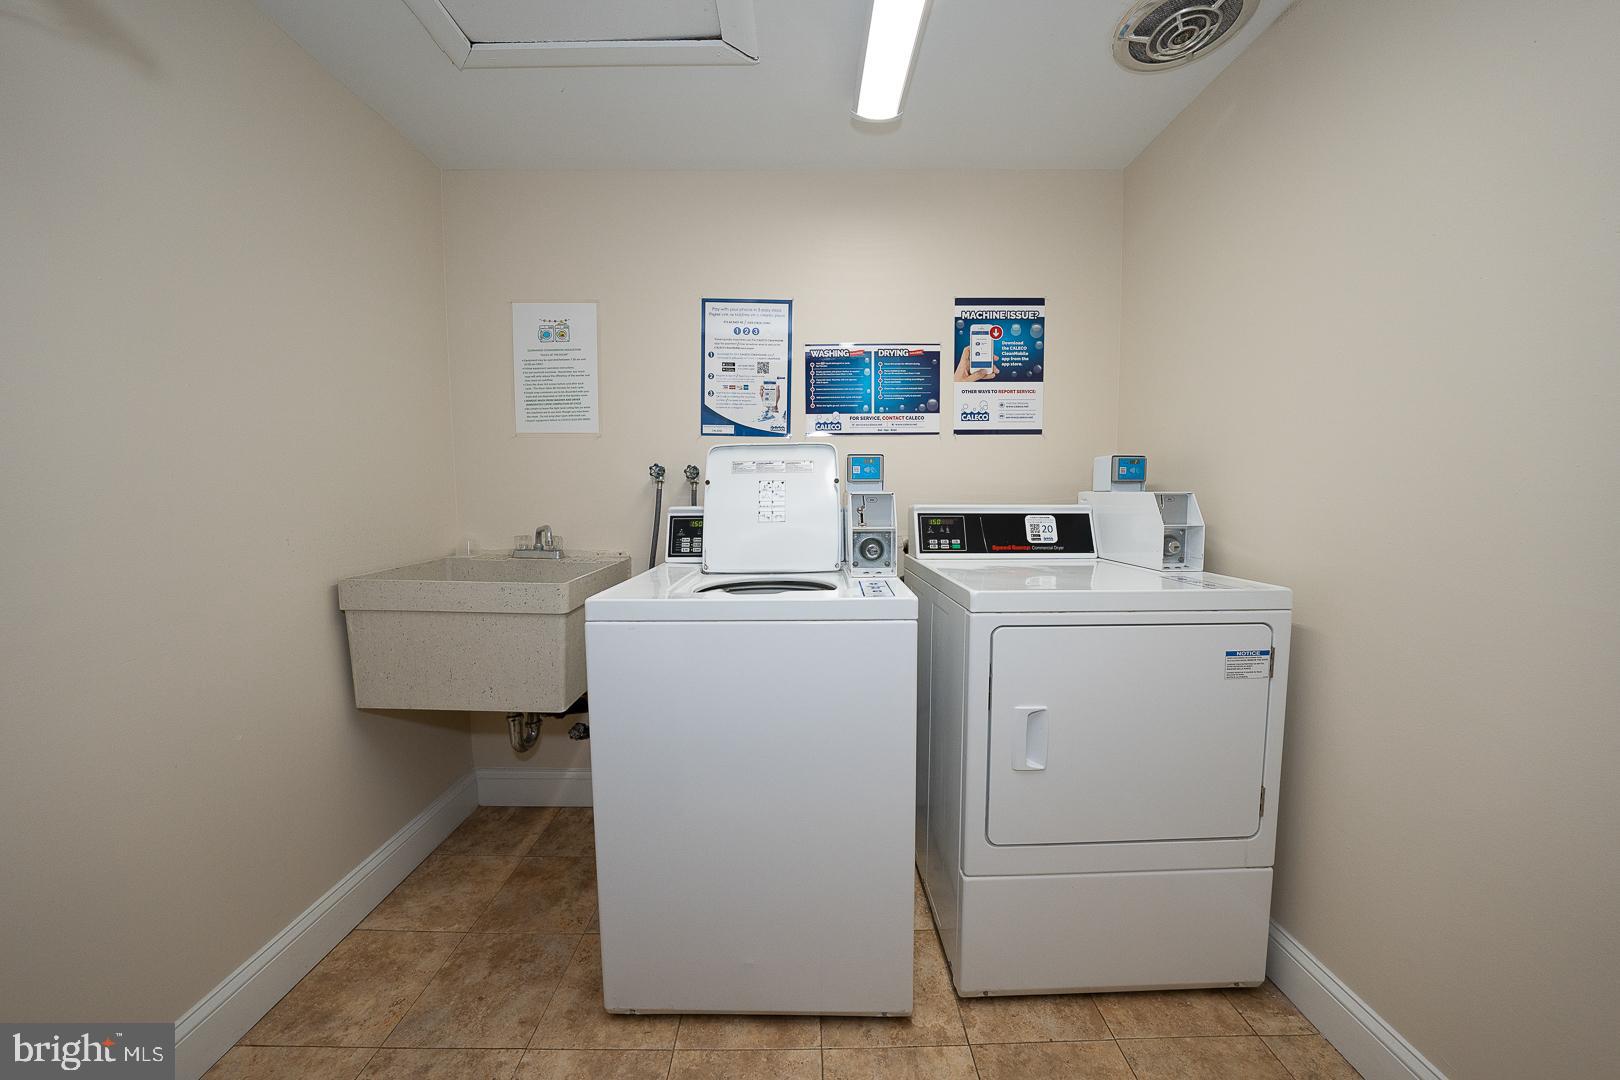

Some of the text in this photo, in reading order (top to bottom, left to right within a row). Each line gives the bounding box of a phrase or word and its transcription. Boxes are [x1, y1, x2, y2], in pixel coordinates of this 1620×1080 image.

[961, 311, 1040, 320] MACHINE ISSUE?
[810, 349, 850, 358] WASHING
[878, 349, 909, 357] DRYING
[961, 413, 989, 421] CALECO
[816, 423, 841, 431] CALECO
[1041, 524, 1054, 533] 20
